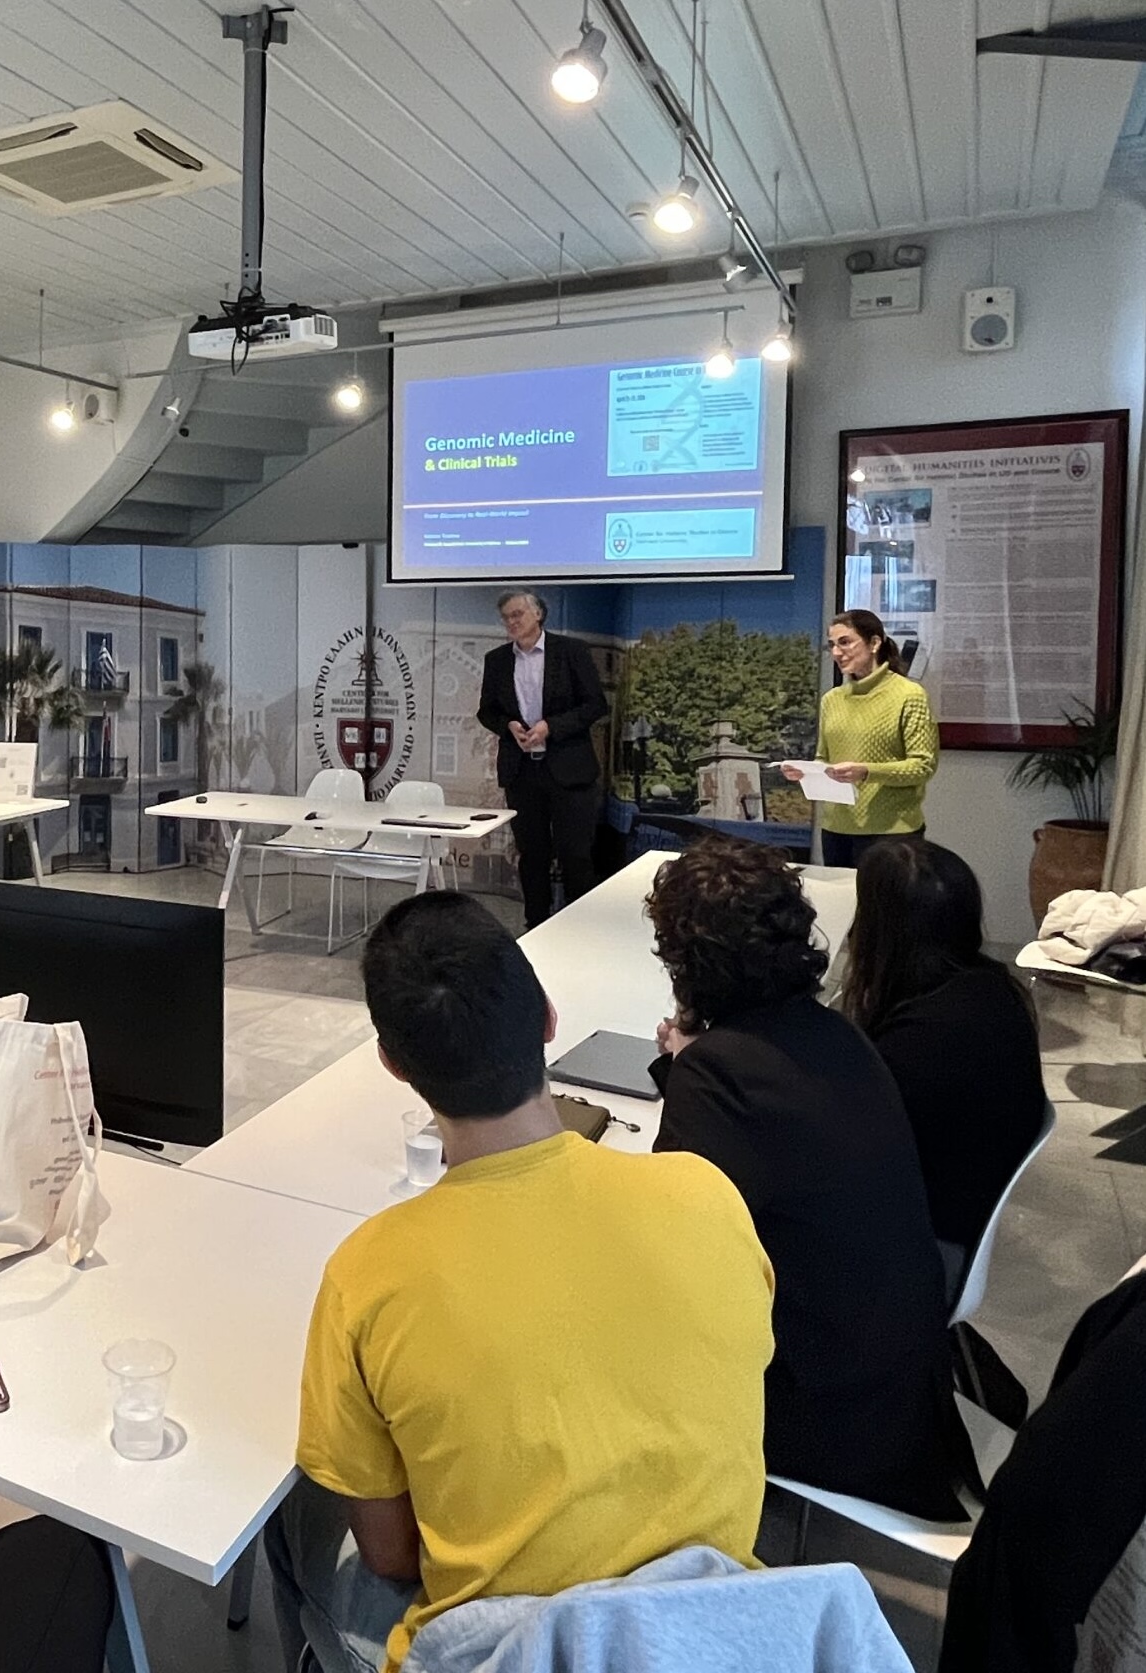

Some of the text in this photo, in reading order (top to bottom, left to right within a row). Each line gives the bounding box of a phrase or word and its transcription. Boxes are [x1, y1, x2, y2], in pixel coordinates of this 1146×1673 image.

[644, 369, 672, 380] Medicine
[425, 429, 575, 452] Genomic Medicine
[424, 454, 518, 472] & Clinical Trials
[913, 459, 986, 472] HUMANITIES
[990, 455, 1061, 467] INITIATIVES
